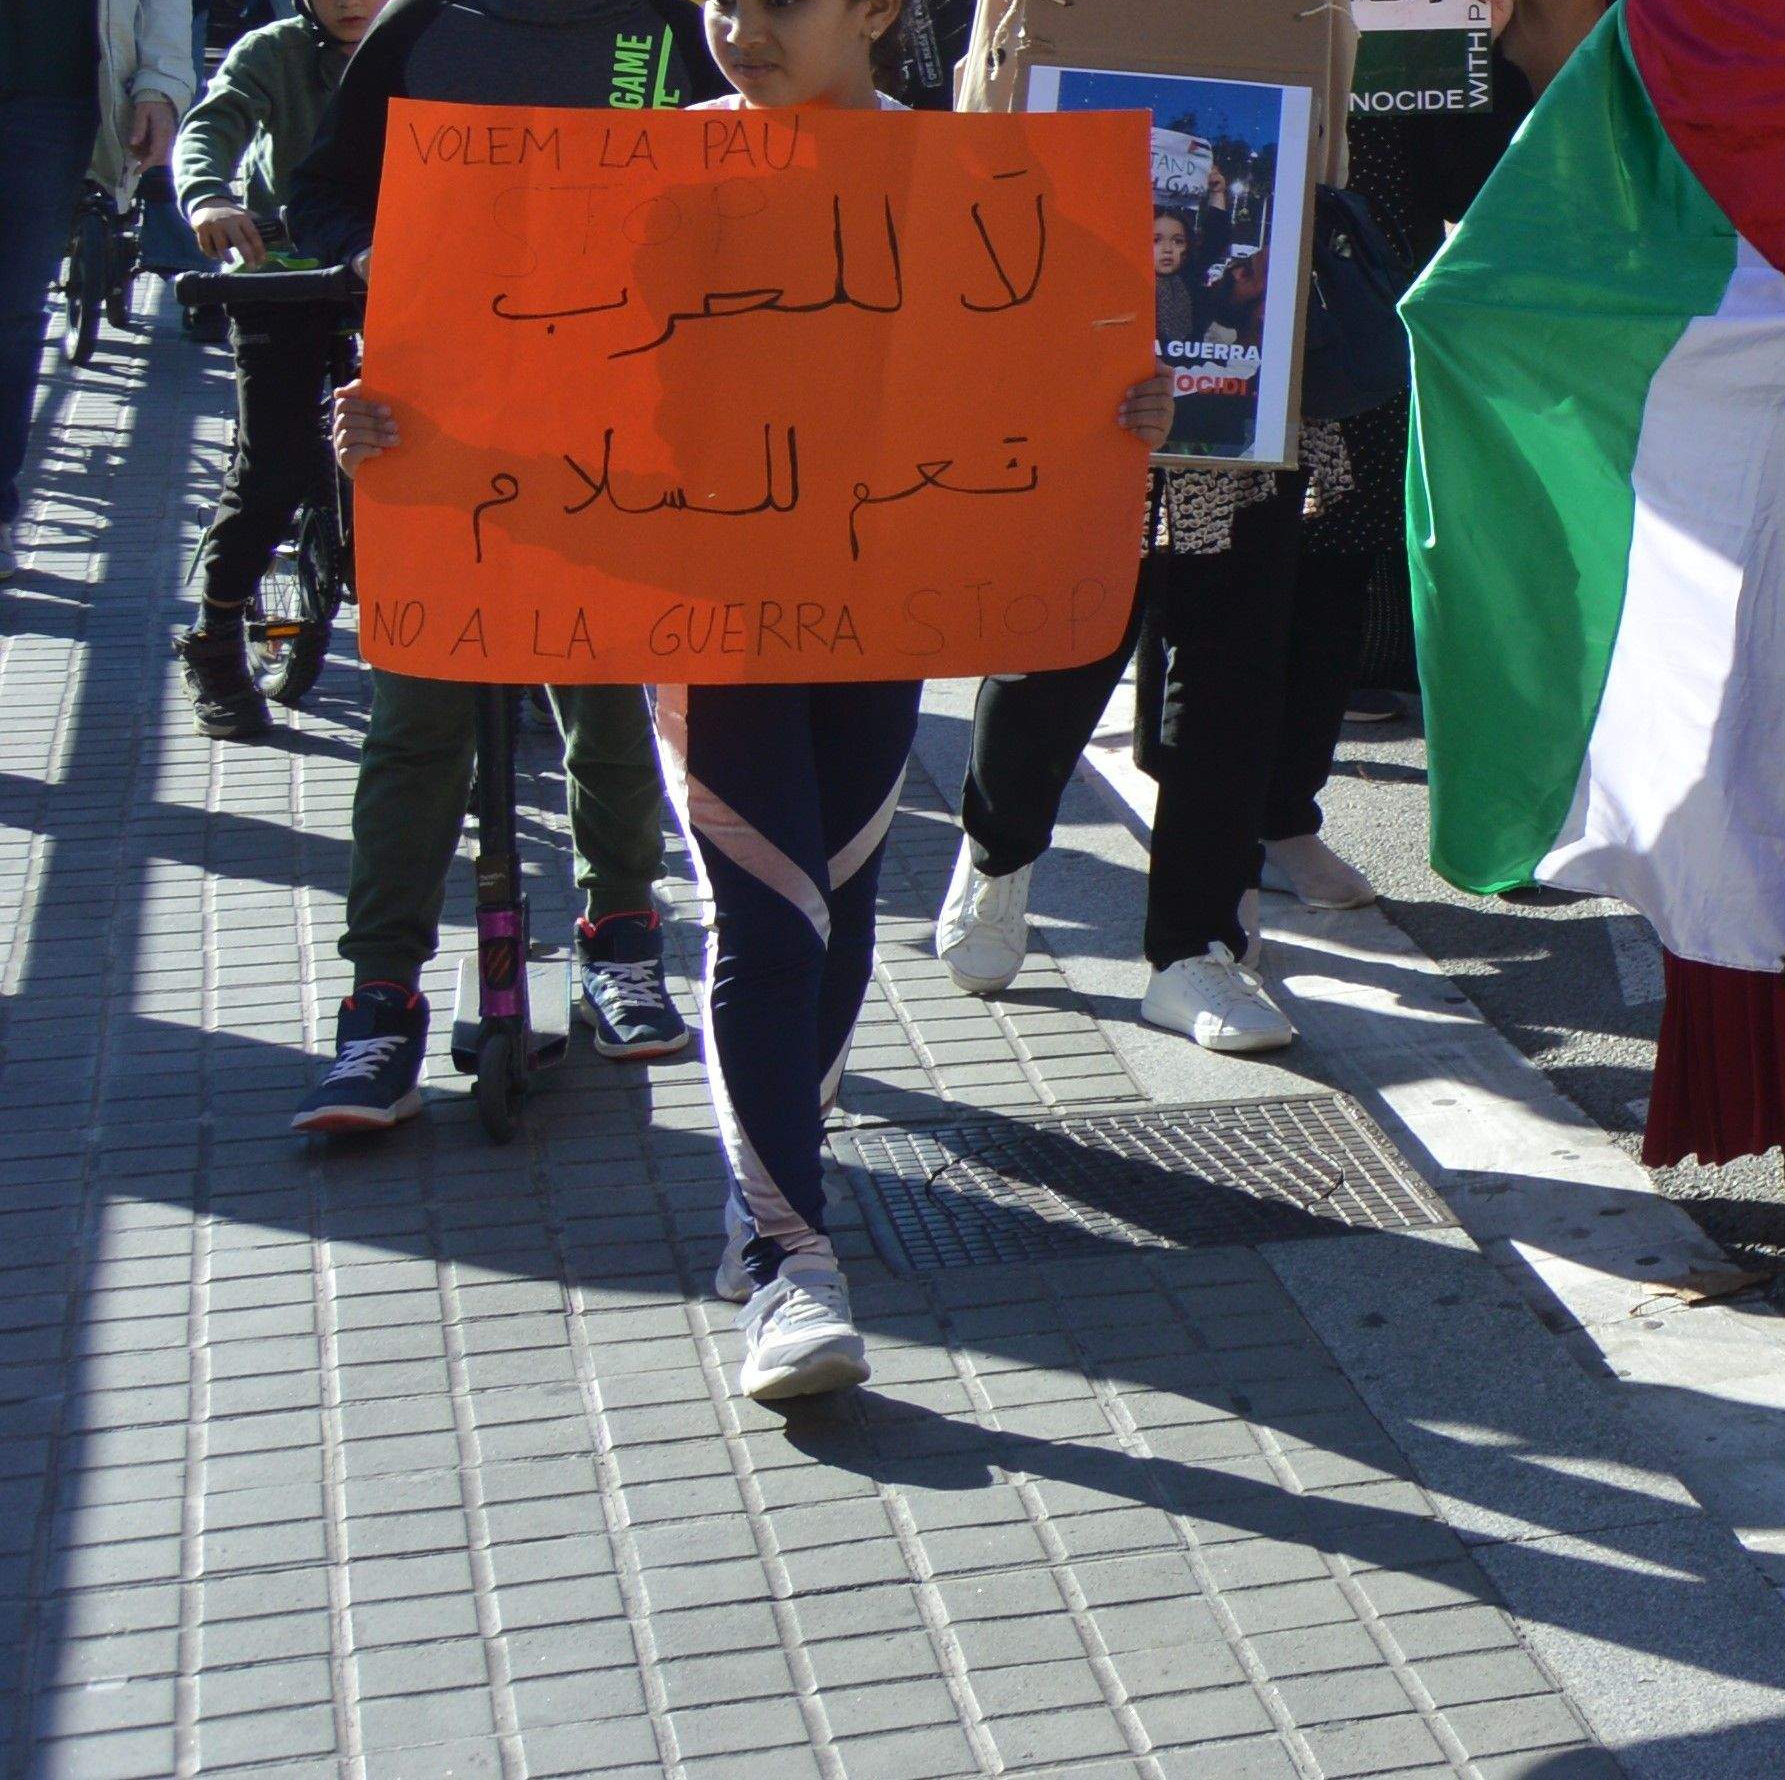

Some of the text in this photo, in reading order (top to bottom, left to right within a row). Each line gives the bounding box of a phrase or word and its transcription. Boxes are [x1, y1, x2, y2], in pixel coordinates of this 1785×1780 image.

[609, 32, 653, 109] GAME
[1467, 32, 1489, 109] WITH
[409, 114, 801, 172] VOLEM LA PAU
[490, 192, 904, 361] للحرب
[1167, 340, 1260, 362] GUERRA
[473, 423, 800, 564] للسلام
[371, 600, 427, 650] NO
[450, 607, 489, 659] A
[532, 605, 595, 661] LA
[649, 600, 866, 660] GUERRA
